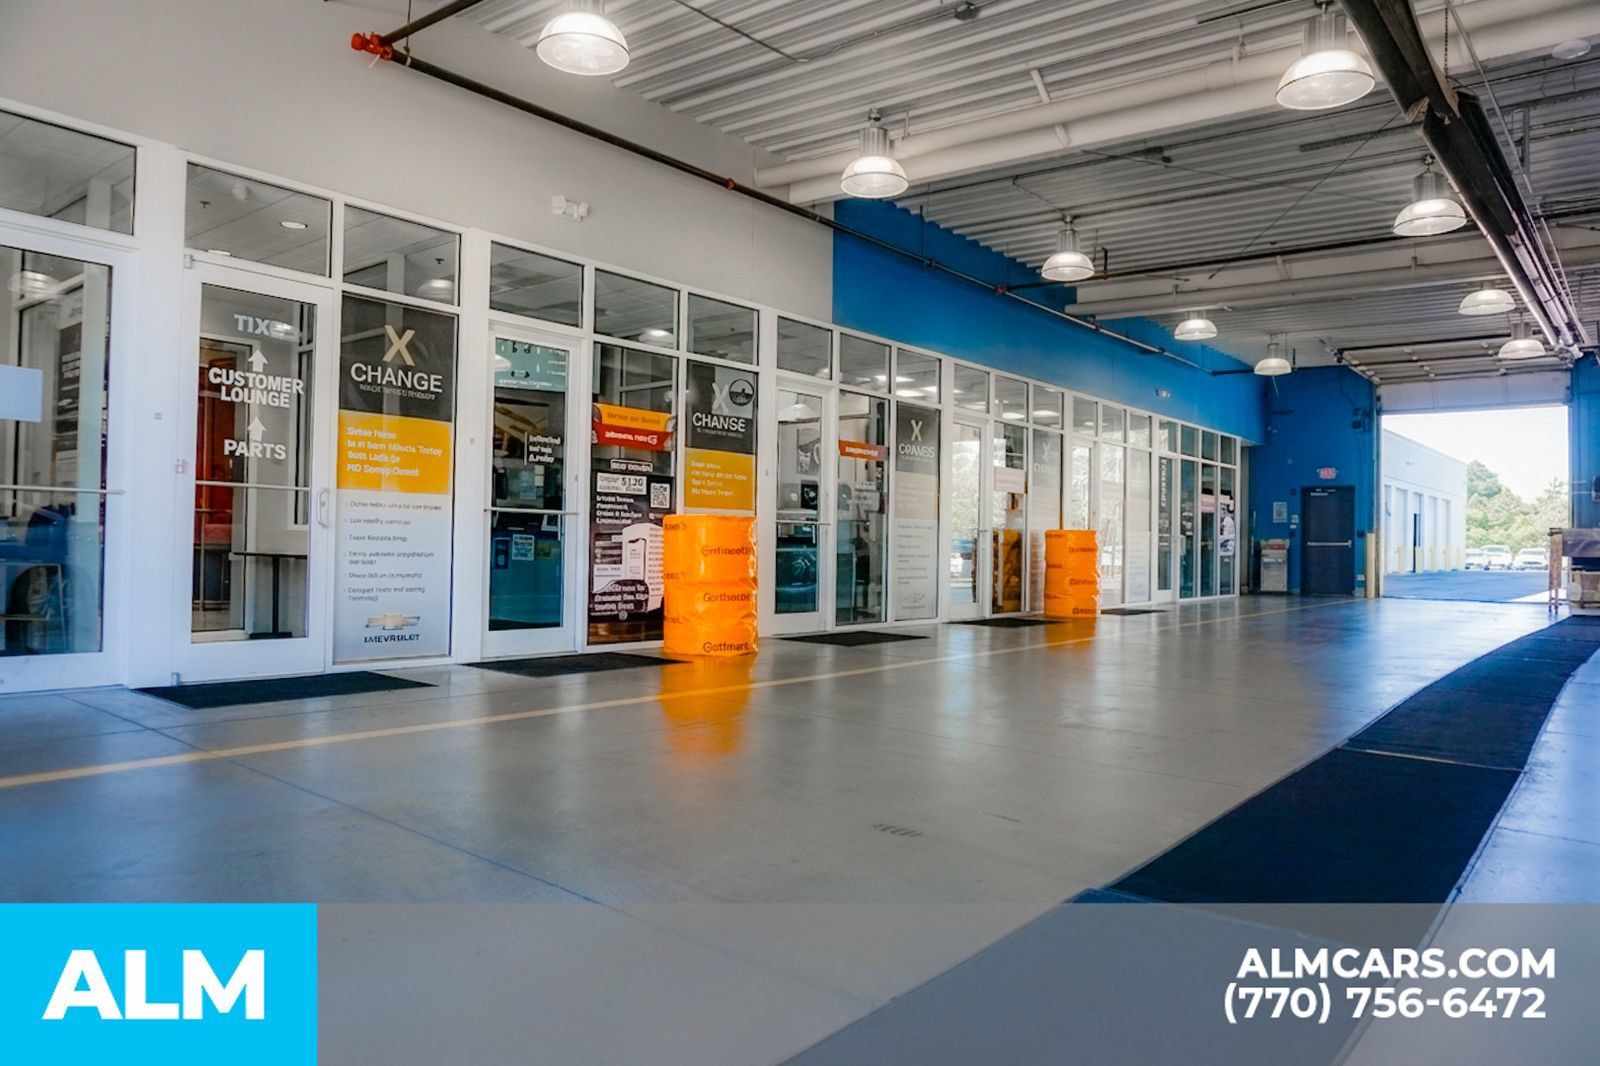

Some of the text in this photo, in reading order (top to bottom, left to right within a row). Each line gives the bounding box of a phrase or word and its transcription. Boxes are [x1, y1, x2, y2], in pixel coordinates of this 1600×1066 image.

[382, 324, 416, 367] X
[208, 366, 304, 395] CUSTOMER
[350, 362, 443, 393] CHANGE
[220, 386, 290, 409] LOUNGE
[223, 439, 287, 460] PARTS
